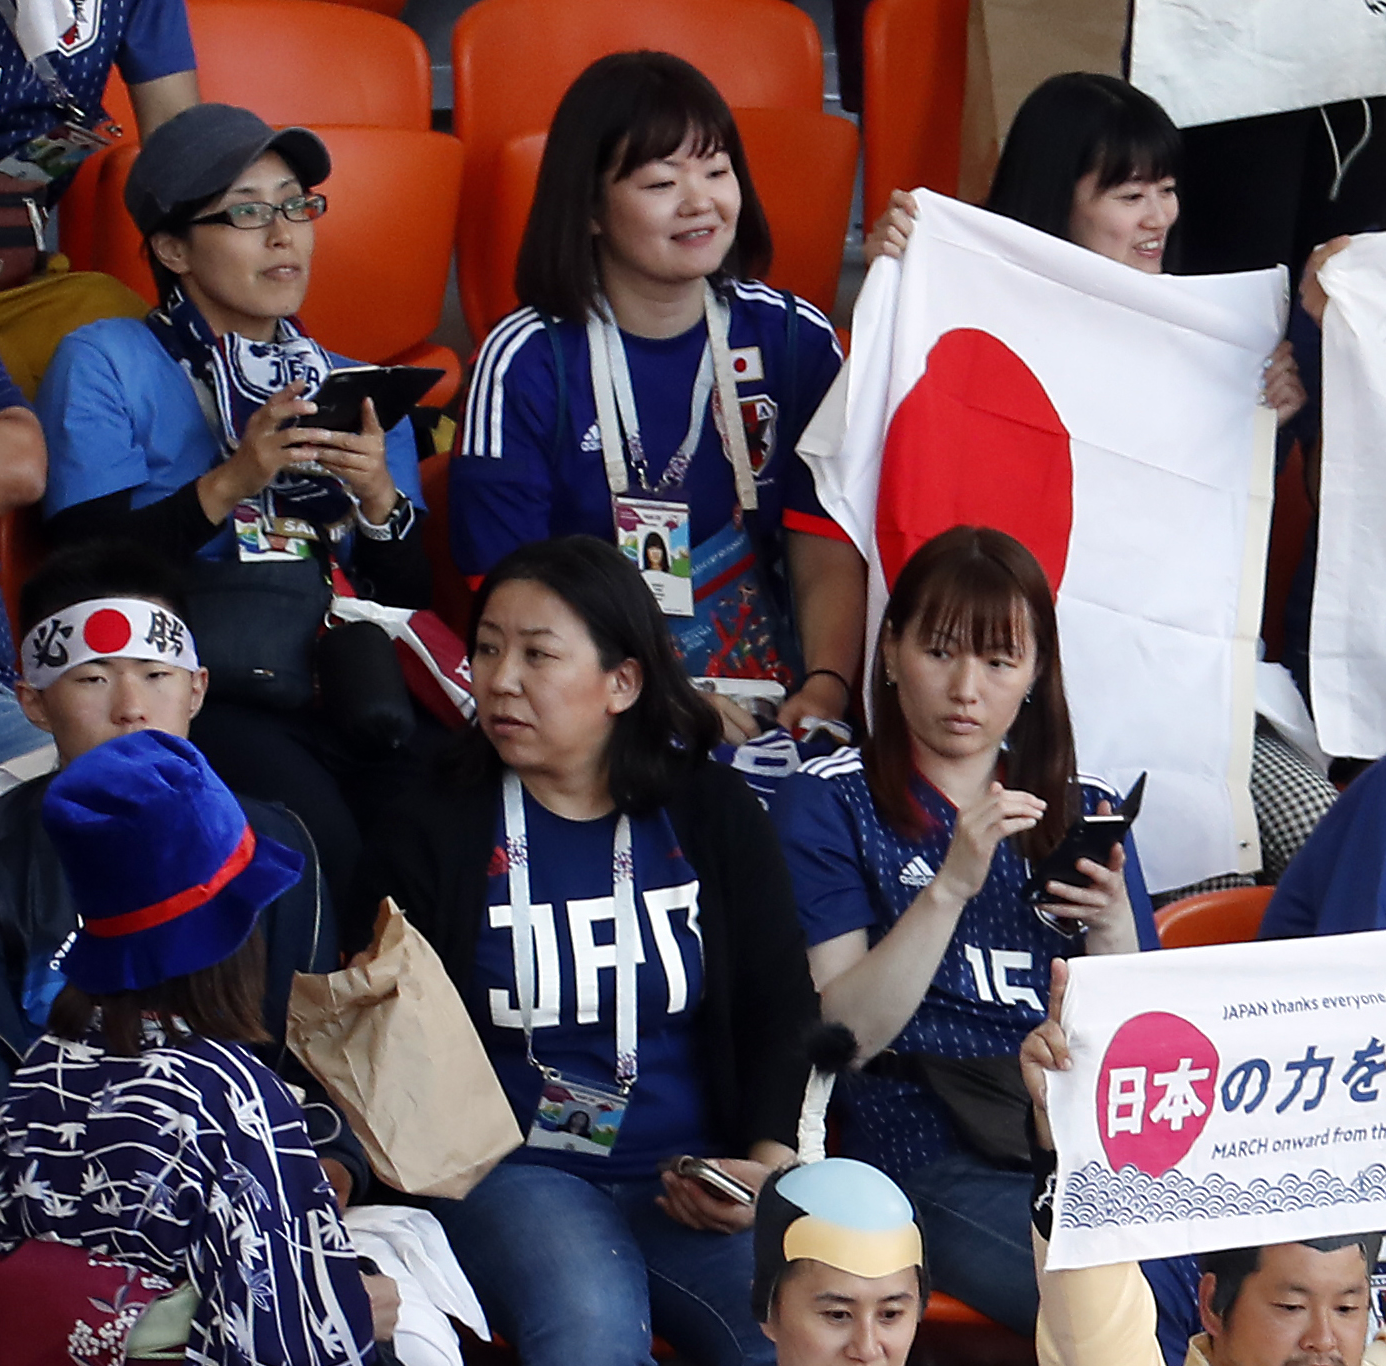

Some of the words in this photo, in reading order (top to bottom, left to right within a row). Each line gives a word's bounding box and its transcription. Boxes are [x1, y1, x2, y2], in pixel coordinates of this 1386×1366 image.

[32, 618, 74, 669] 必
[1222, 1002, 1269, 1021] JAPAN
[1272, 996, 1319, 1015] thanks
[1323, 991, 1386, 1010] everyone
[1211, 1138, 1269, 1160] MARCH
[1272, 1127, 1330, 1153] onward
[1332, 1126, 1368, 1143] from
